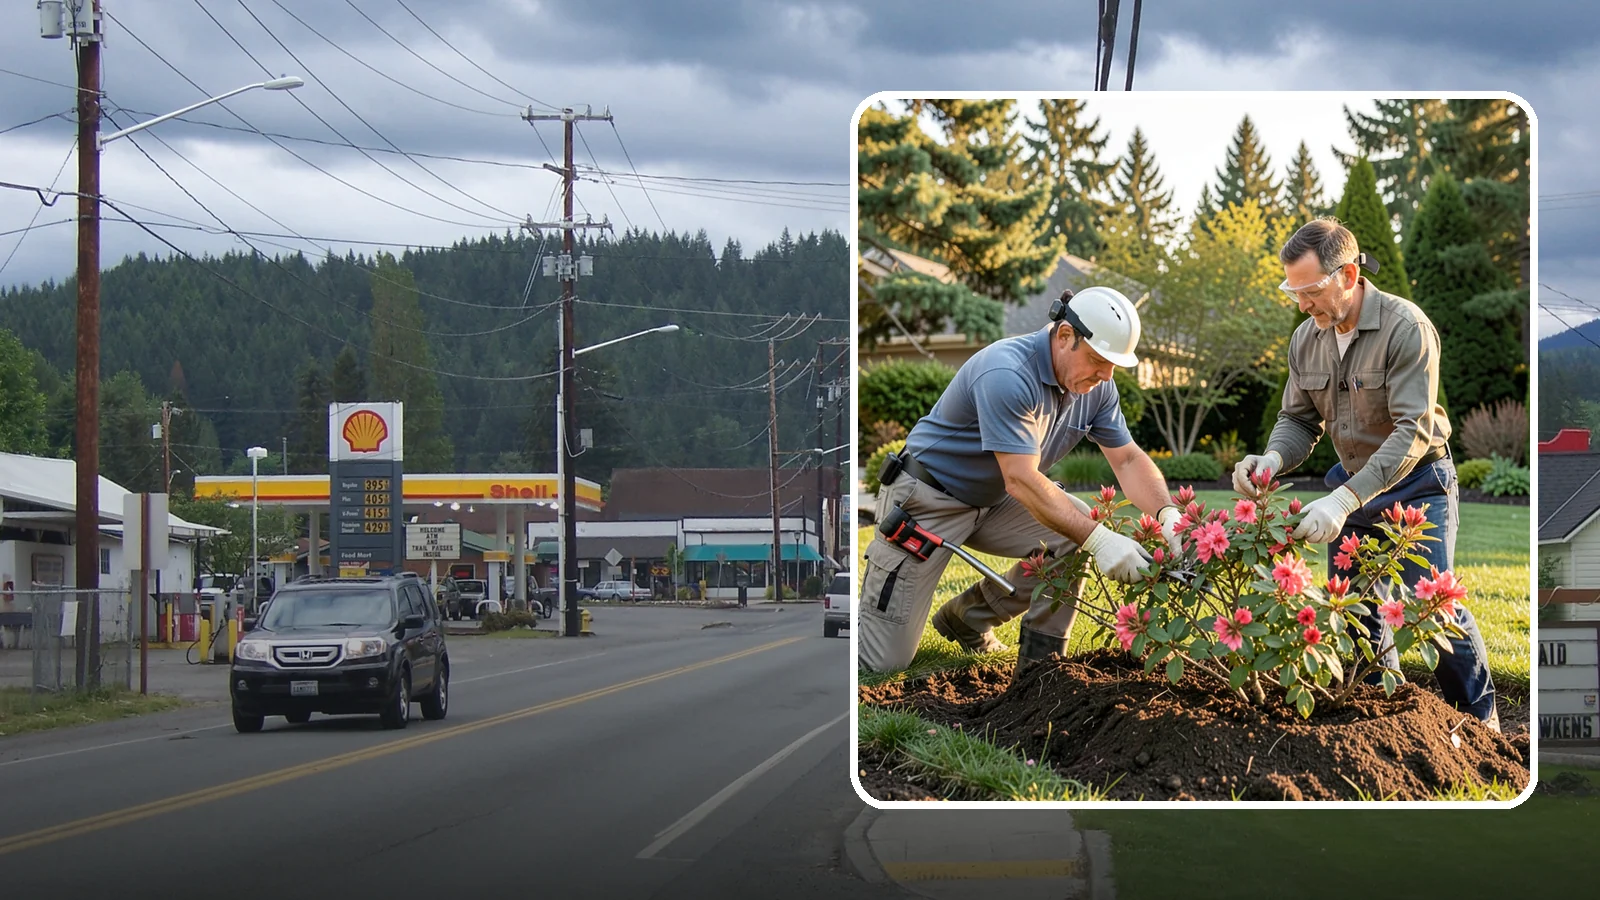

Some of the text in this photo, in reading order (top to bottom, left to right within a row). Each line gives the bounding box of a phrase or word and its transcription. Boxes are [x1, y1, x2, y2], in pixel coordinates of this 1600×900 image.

[366, 480, 384, 490] 395
[490, 484, 547, 499] Shell
[366, 494, 384, 504] 405
[366, 508, 384, 518] 415
[366, 522, 384, 533] 429
[1538, 642, 1567, 666] AID
